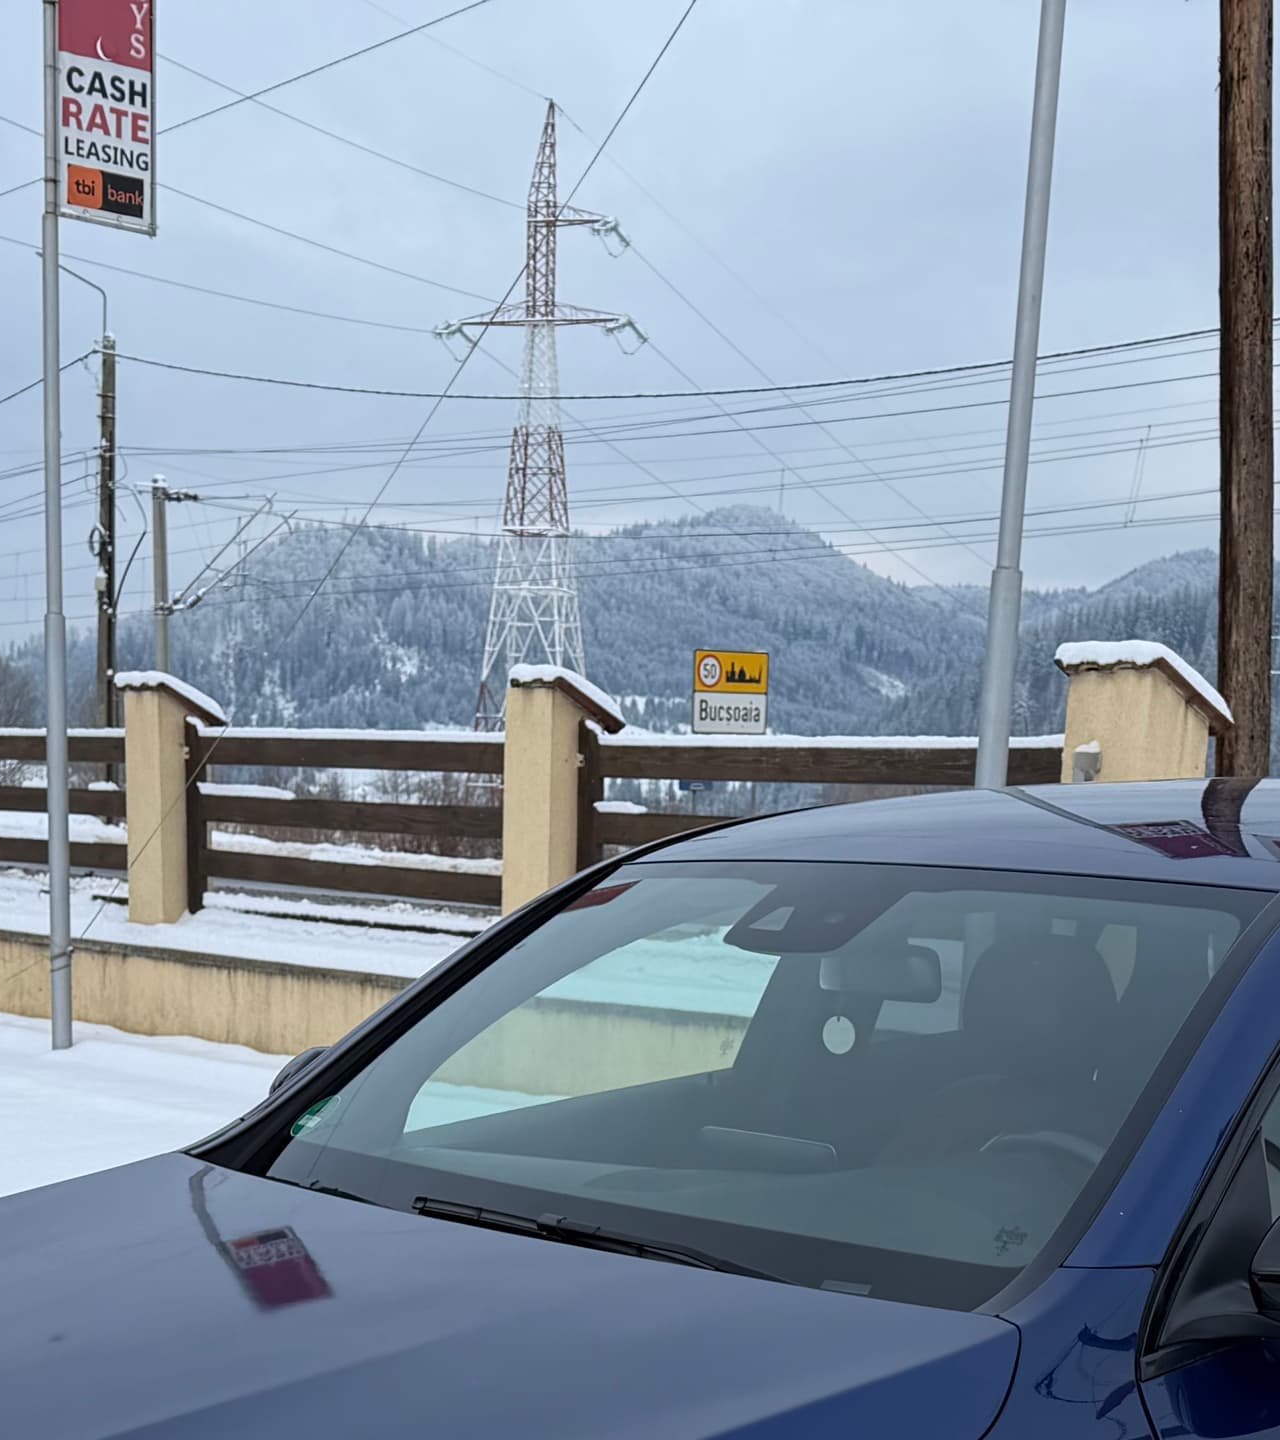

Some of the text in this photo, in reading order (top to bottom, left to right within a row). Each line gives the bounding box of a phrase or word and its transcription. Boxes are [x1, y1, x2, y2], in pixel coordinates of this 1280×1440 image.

[66, 66, 148, 108] CASH
[61, 96, 150, 145] RATE
[64, 136, 150, 171] LEASING
[74, 179, 144, 206] tbi bank
[703, 663, 717, 679] 50
